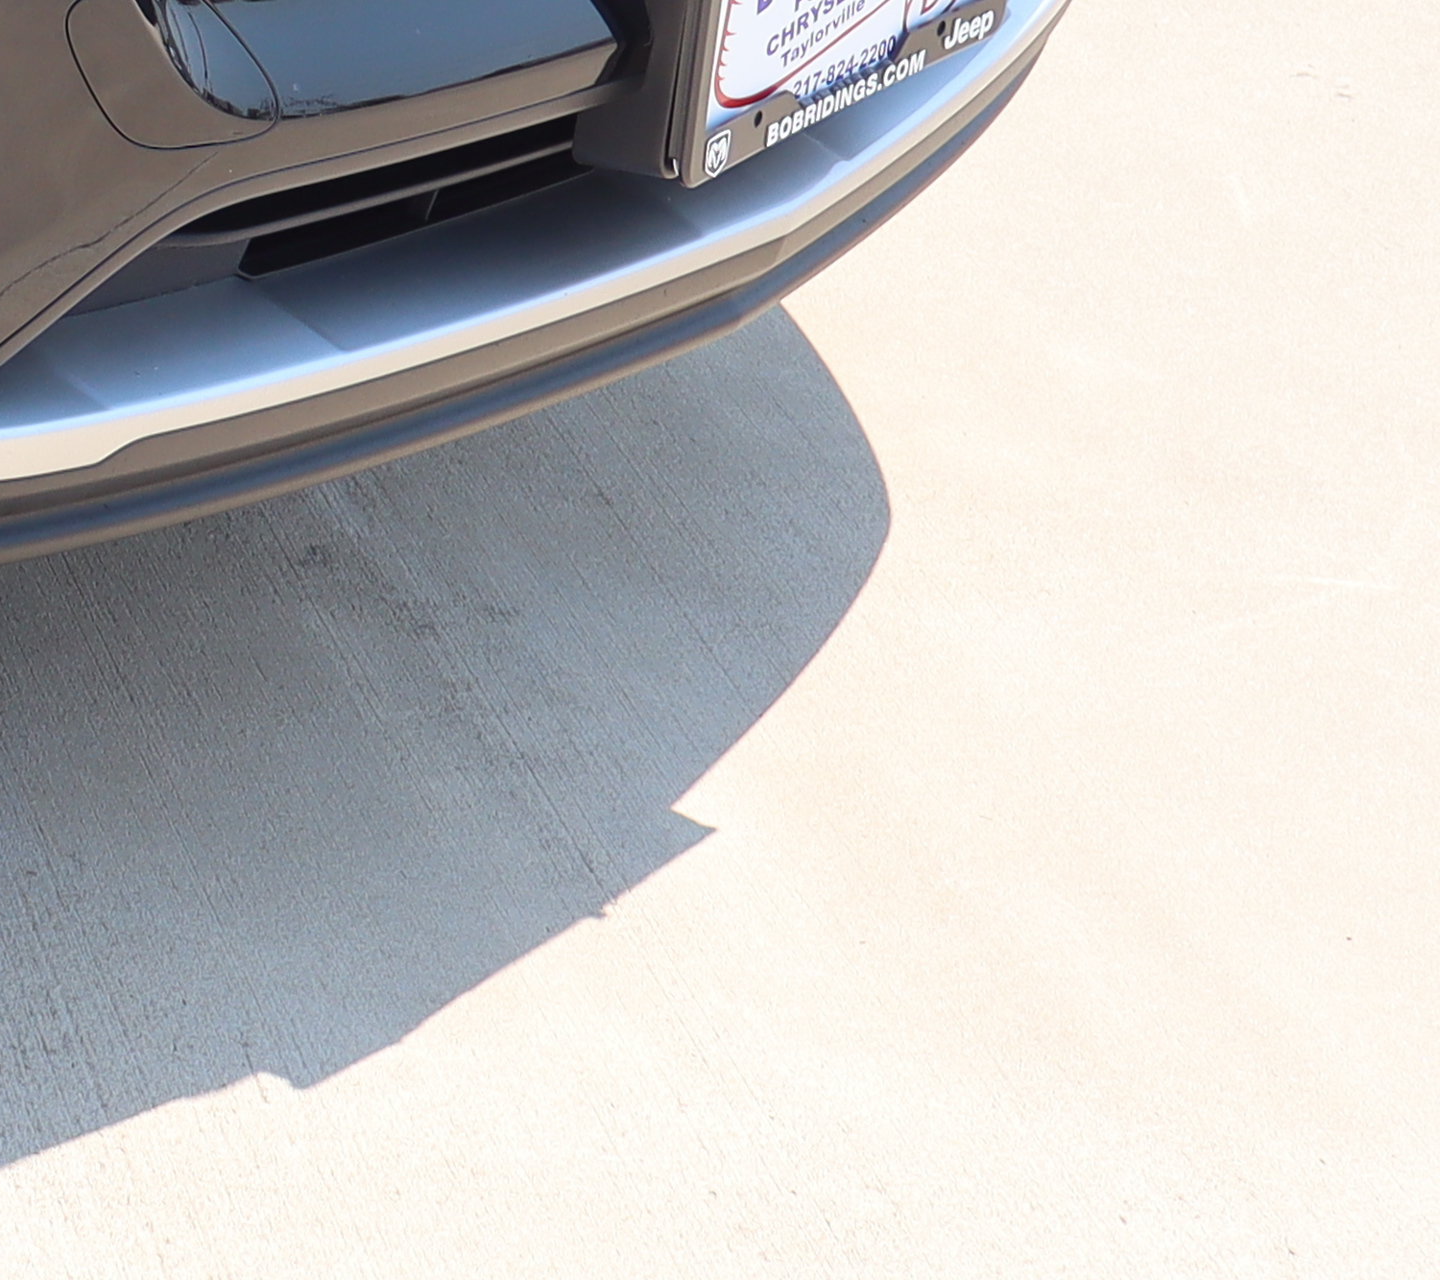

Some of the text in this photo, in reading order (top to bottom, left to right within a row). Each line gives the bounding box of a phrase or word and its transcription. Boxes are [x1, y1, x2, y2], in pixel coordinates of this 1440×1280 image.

[943, 10, 995, 50] Jeep
[765, 49, 926, 147] BOBRIDINGS.COM
[792, 35, 898, 99] 217-824-2200
